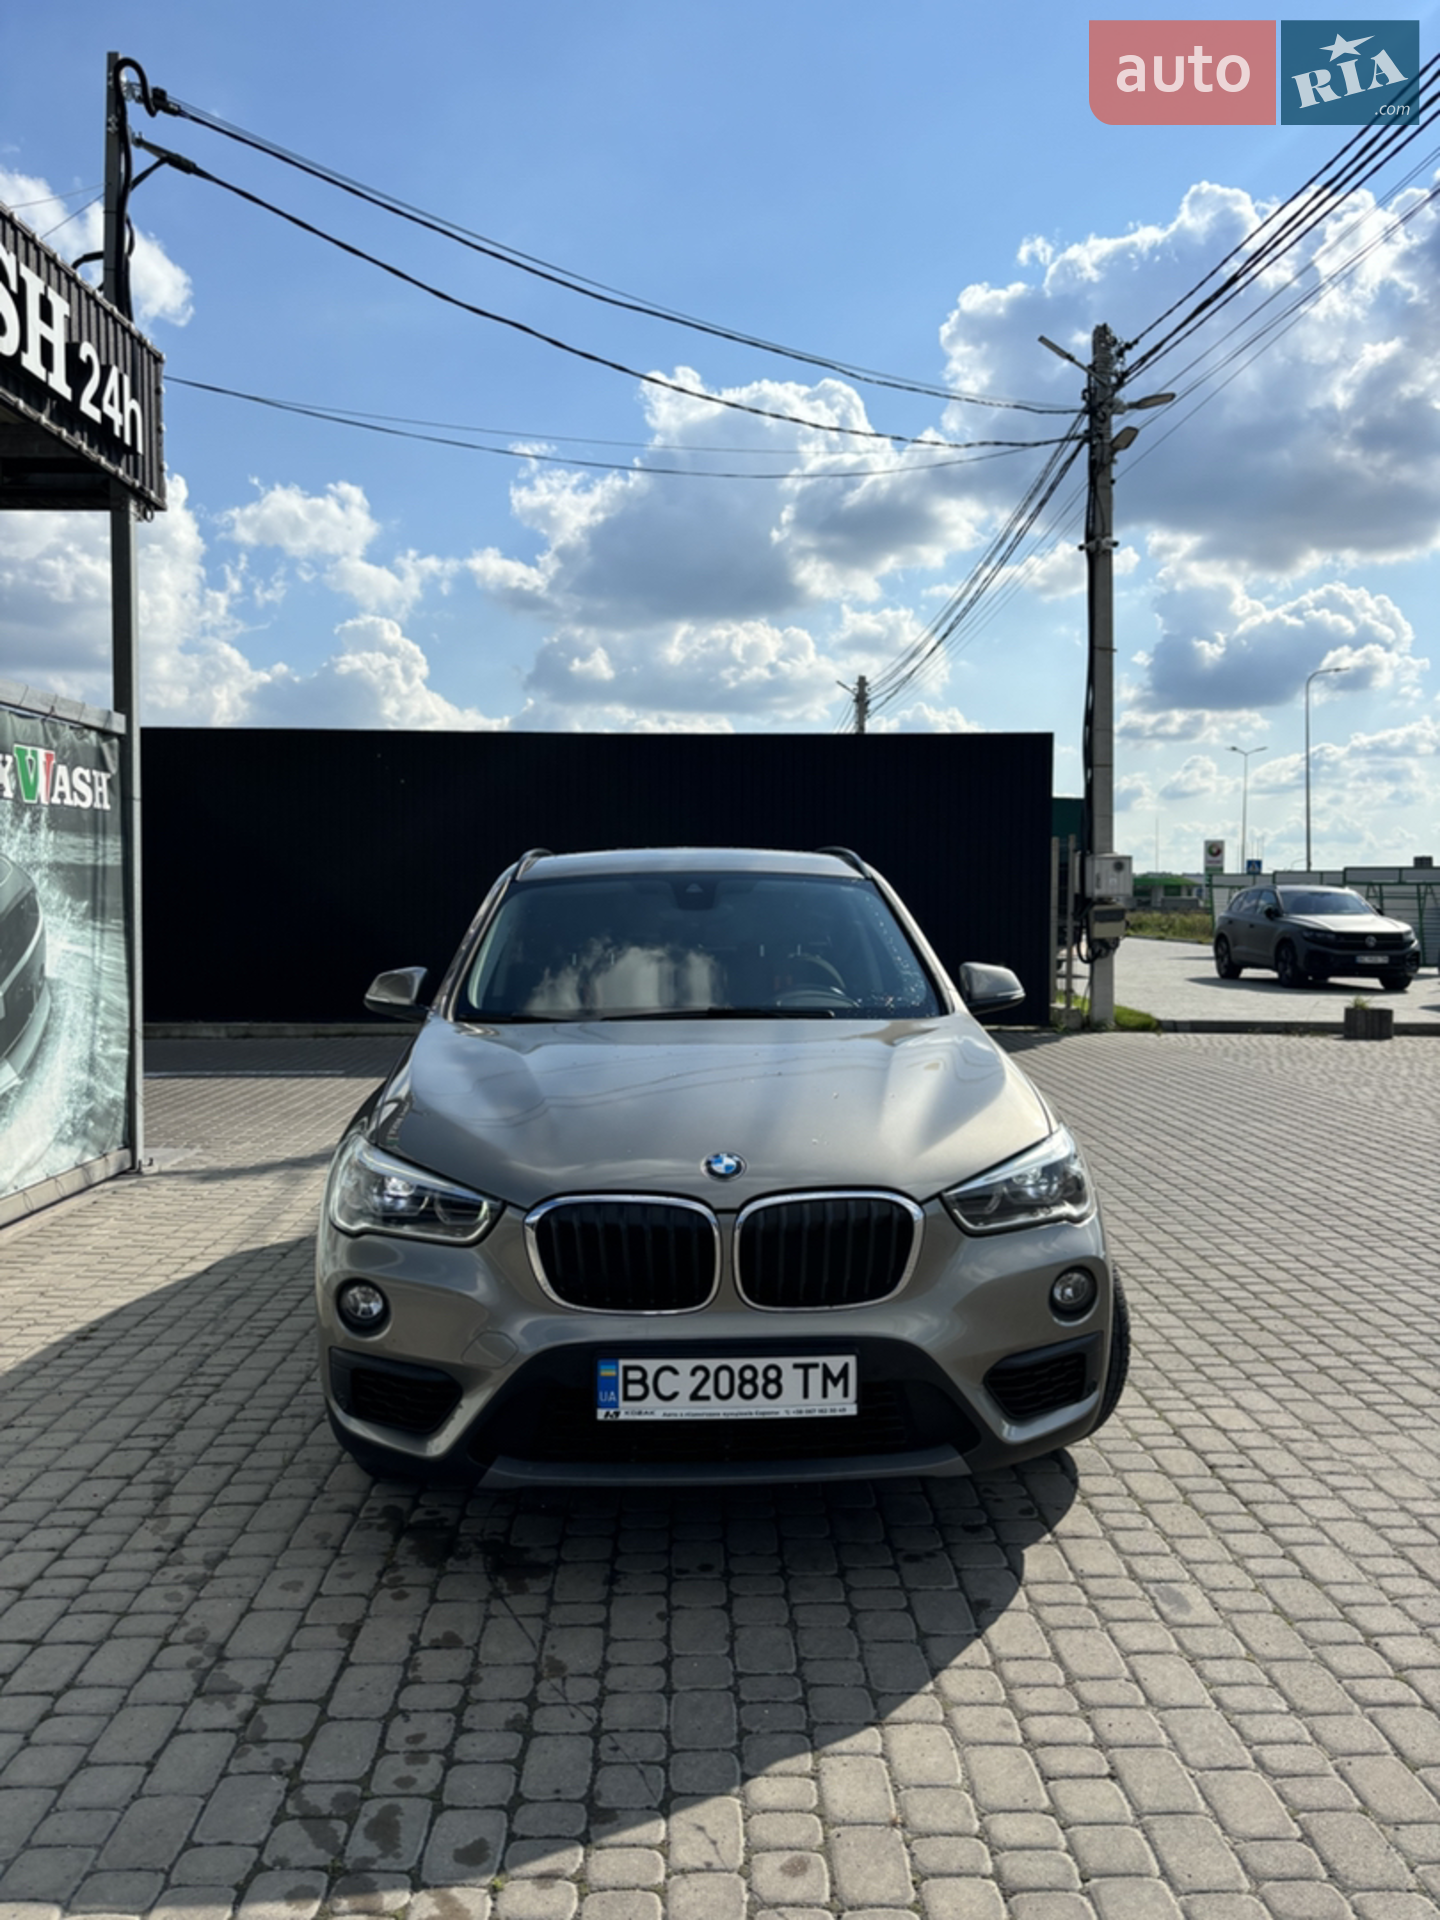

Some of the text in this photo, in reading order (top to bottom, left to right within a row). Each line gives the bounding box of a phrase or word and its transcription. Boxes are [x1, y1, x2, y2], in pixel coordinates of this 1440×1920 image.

[79, 341, 144, 456] 24h
[599, 1391, 616, 1402] UA
[622, 1362, 849, 1402] BC 2088 TM
